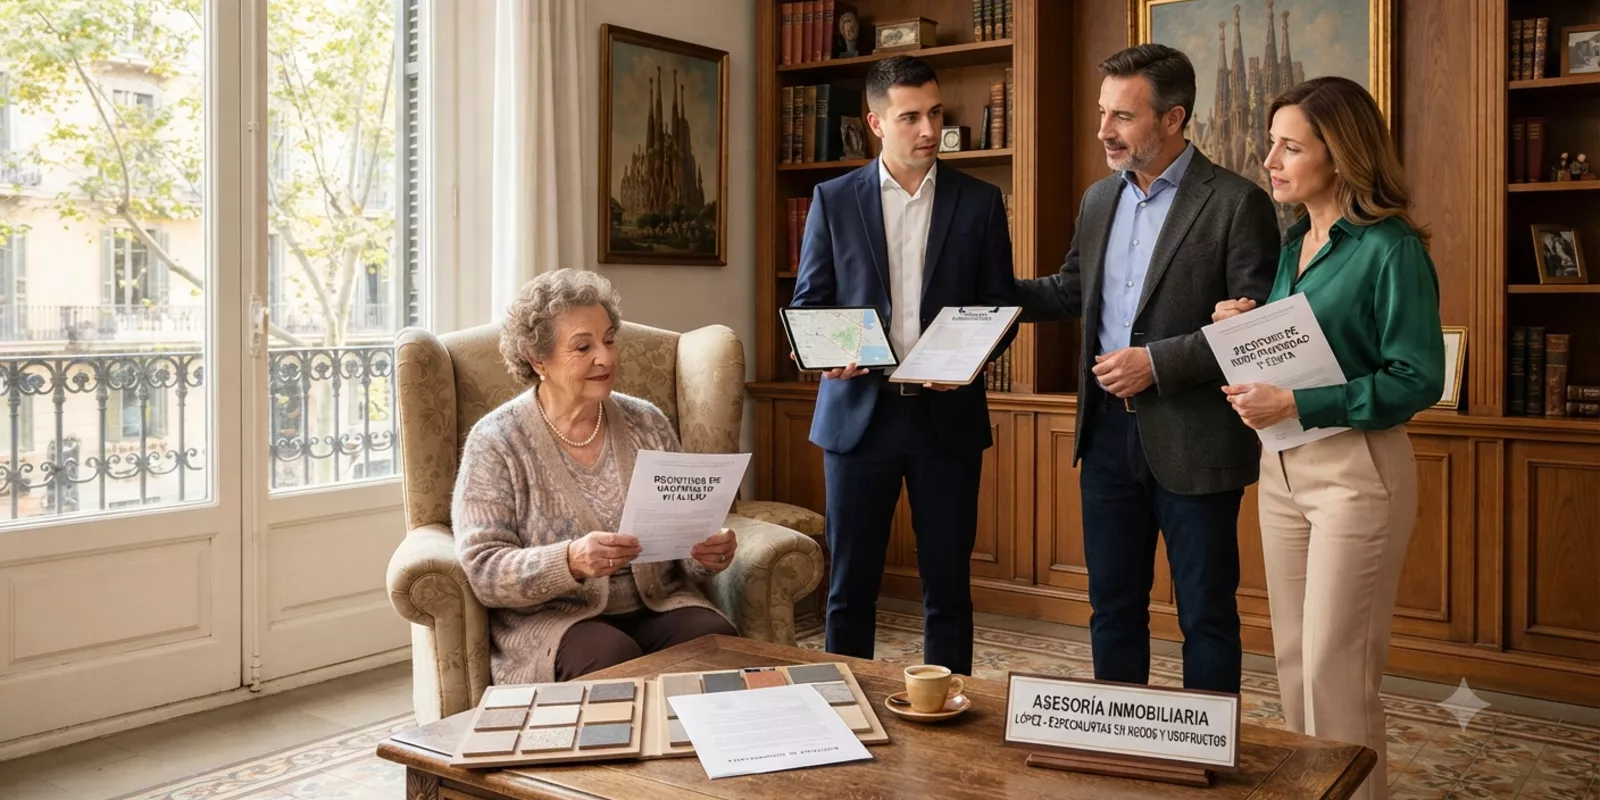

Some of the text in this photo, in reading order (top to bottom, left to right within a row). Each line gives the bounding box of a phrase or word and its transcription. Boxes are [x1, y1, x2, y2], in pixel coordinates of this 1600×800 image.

[1032, 694, 1209, 726] ASESORÍA INMOBILIARIA
[1159, 729, 1166, 741] Y
[1167, 730, 1227, 748] USOFRUCTOS
